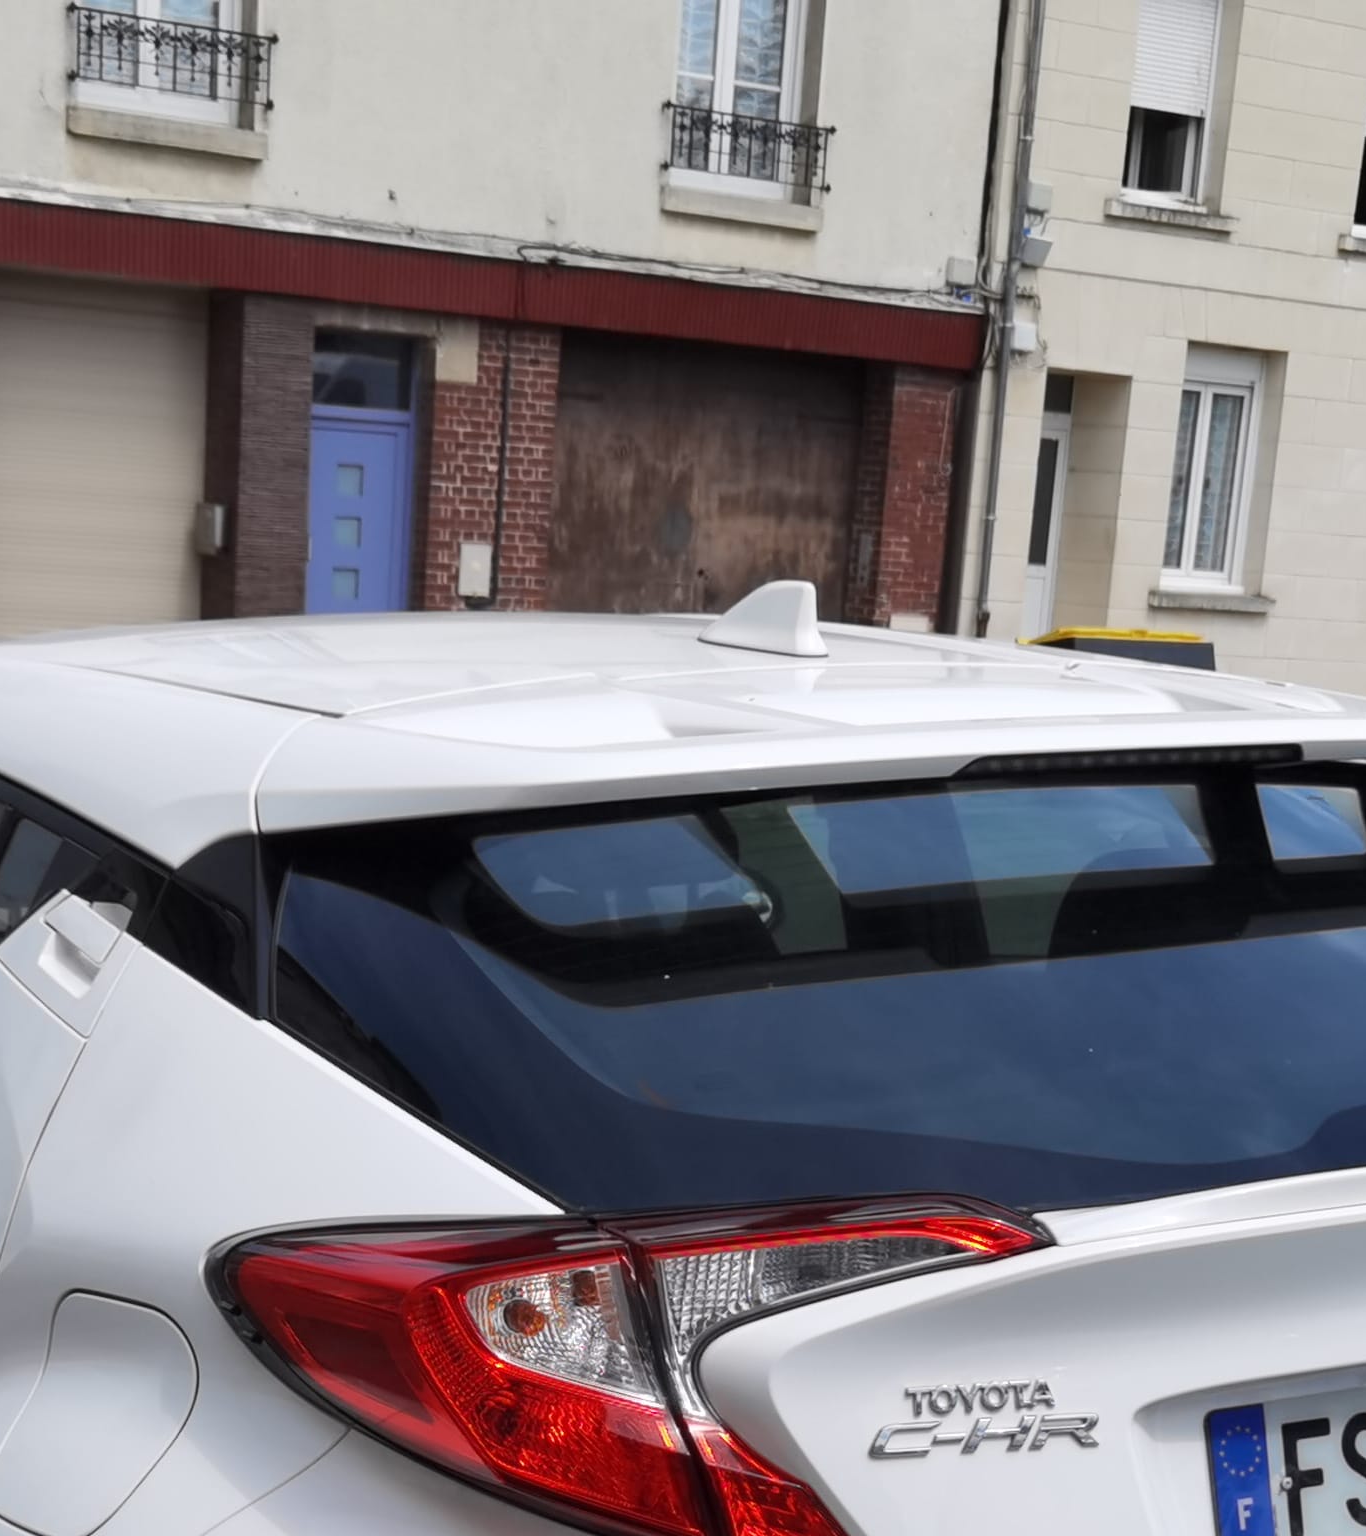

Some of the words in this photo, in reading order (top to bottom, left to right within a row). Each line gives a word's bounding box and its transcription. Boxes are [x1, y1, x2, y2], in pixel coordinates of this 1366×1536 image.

[903, 1377, 1055, 1418] TOYOTA
[867, 1412, 1100, 1461] C-HR
[1236, 1497, 1255, 1532] F
